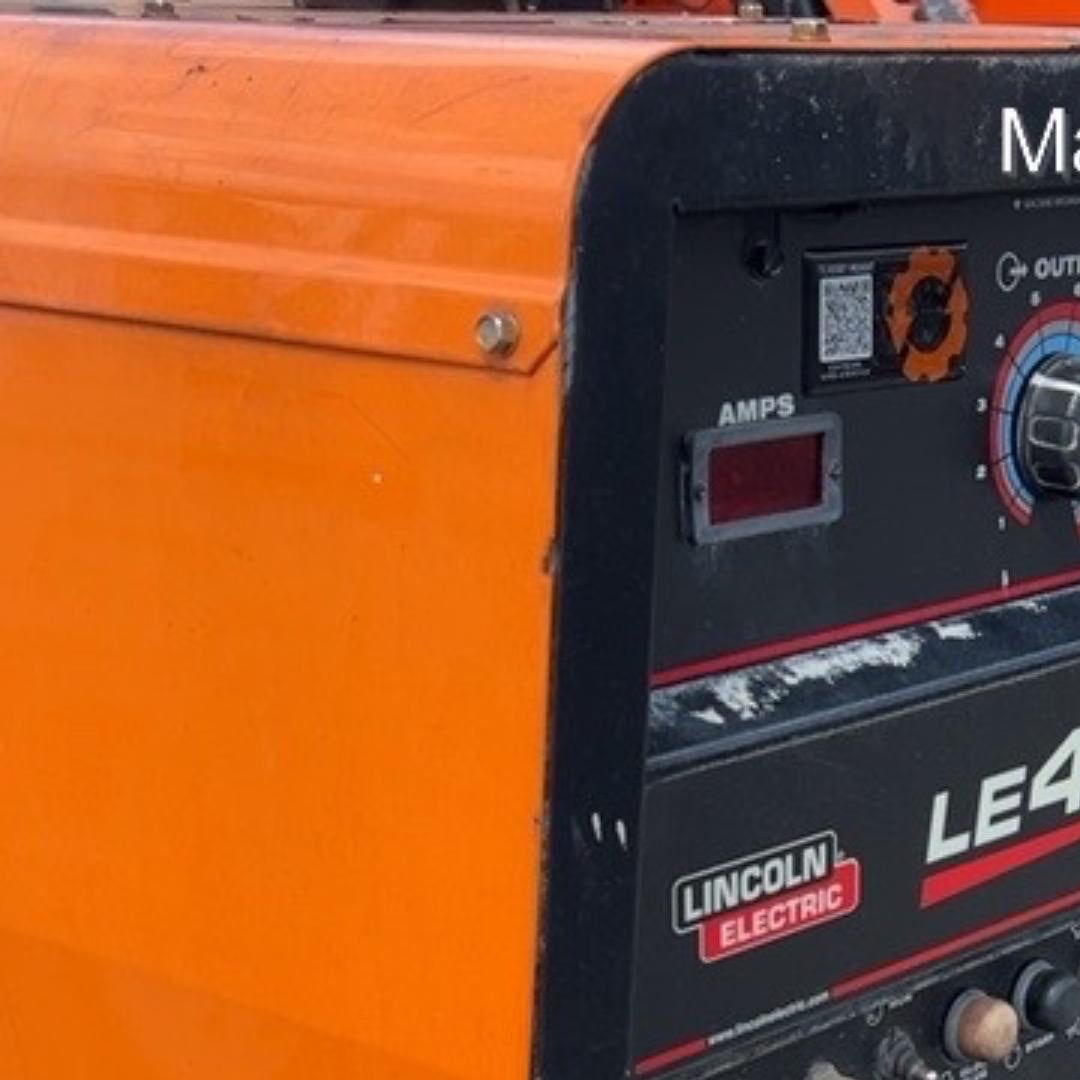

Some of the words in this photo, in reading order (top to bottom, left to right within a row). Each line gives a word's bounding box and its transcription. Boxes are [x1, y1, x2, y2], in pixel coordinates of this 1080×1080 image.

[717, 394, 796, 427] AMPS
[683, 842, 827, 922] LINCOLN
[719, 884, 843, 948] ELECTRIC
